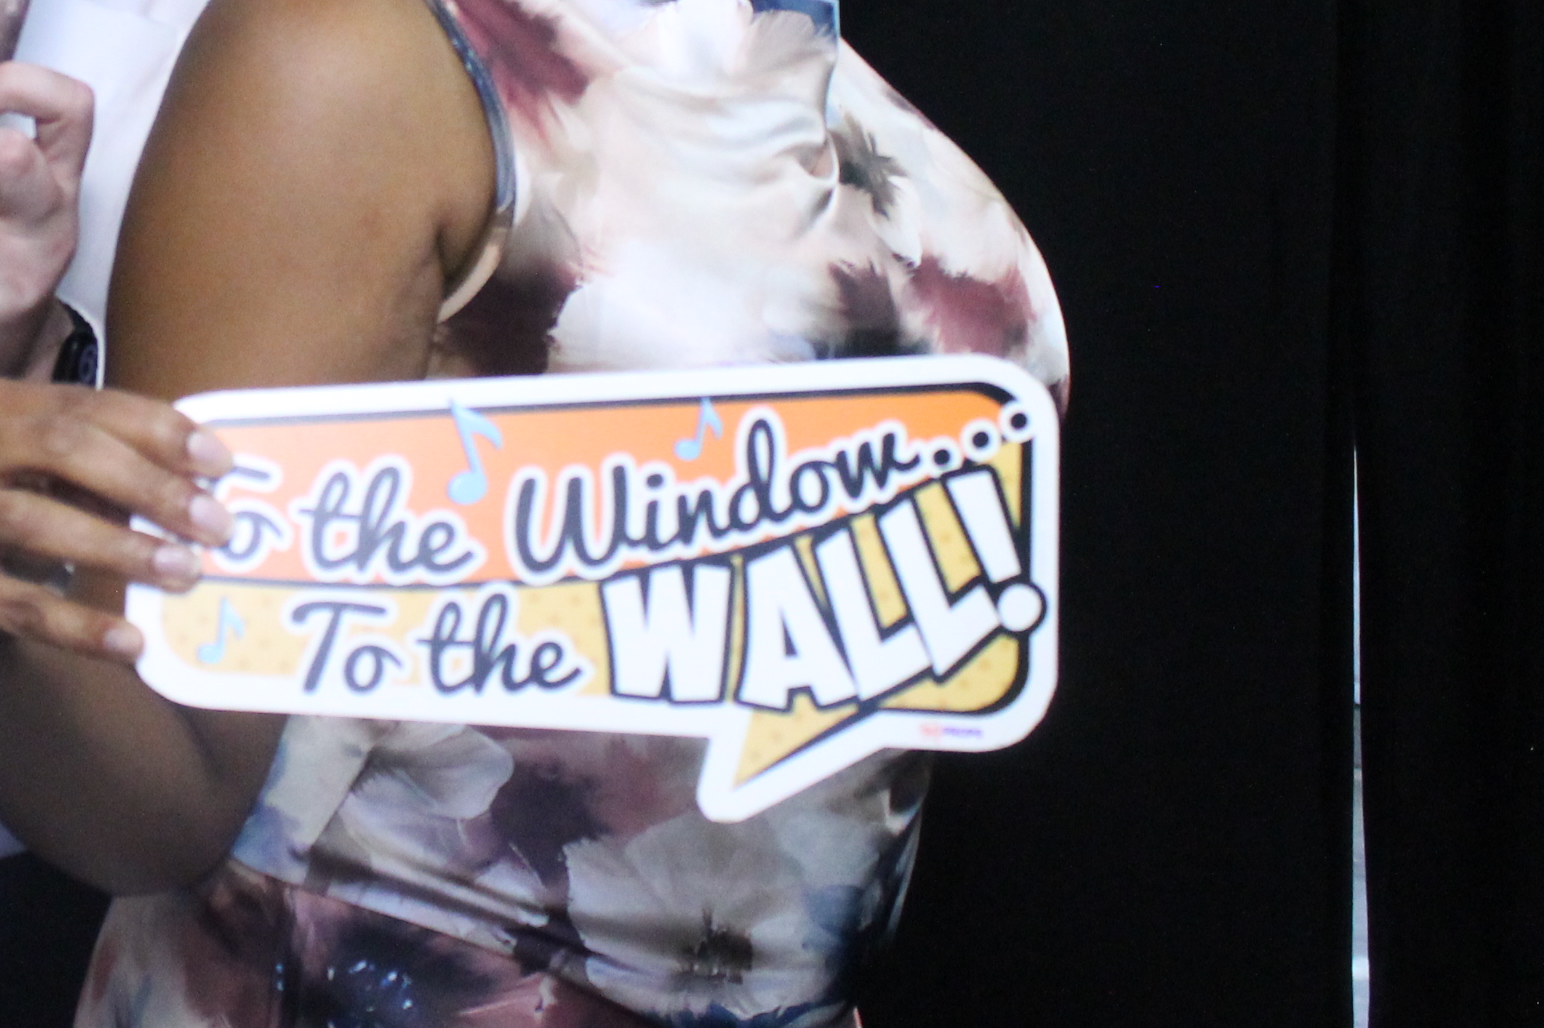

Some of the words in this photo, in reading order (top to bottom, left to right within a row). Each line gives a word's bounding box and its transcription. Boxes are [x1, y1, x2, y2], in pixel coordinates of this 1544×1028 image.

[290, 600, 403, 694] To
[416, 592, 582, 695] the
[599, 465, 1048, 711] WALL!
[298, 467, 474, 573] the
[514, 411, 1029, 574] Window...
